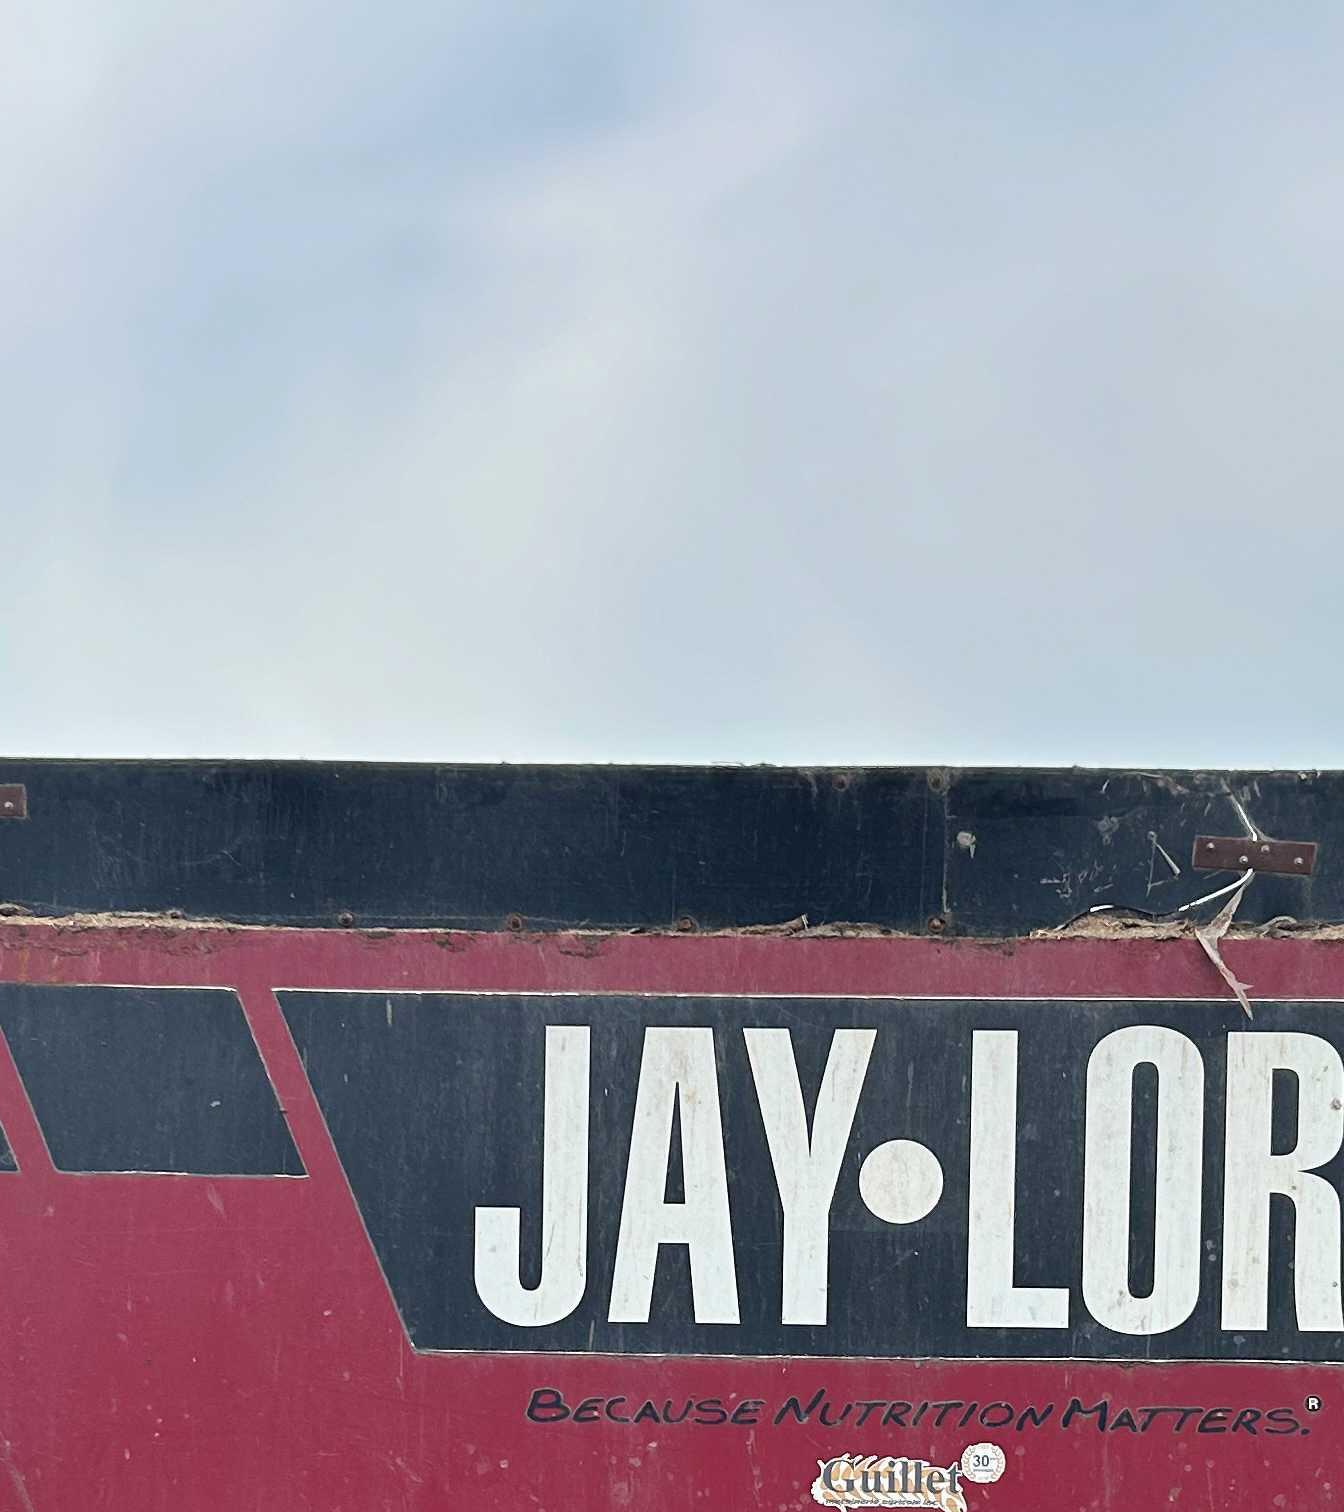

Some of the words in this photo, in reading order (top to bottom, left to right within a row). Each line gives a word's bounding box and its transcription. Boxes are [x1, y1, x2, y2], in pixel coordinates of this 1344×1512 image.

[526, 1388, 762, 1426] BECAUSE
[773, 1387, 1055, 1431] NUTRITION
[822, 1459, 963, 1495] Guillet
[972, 1454, 991, 1468] 30
